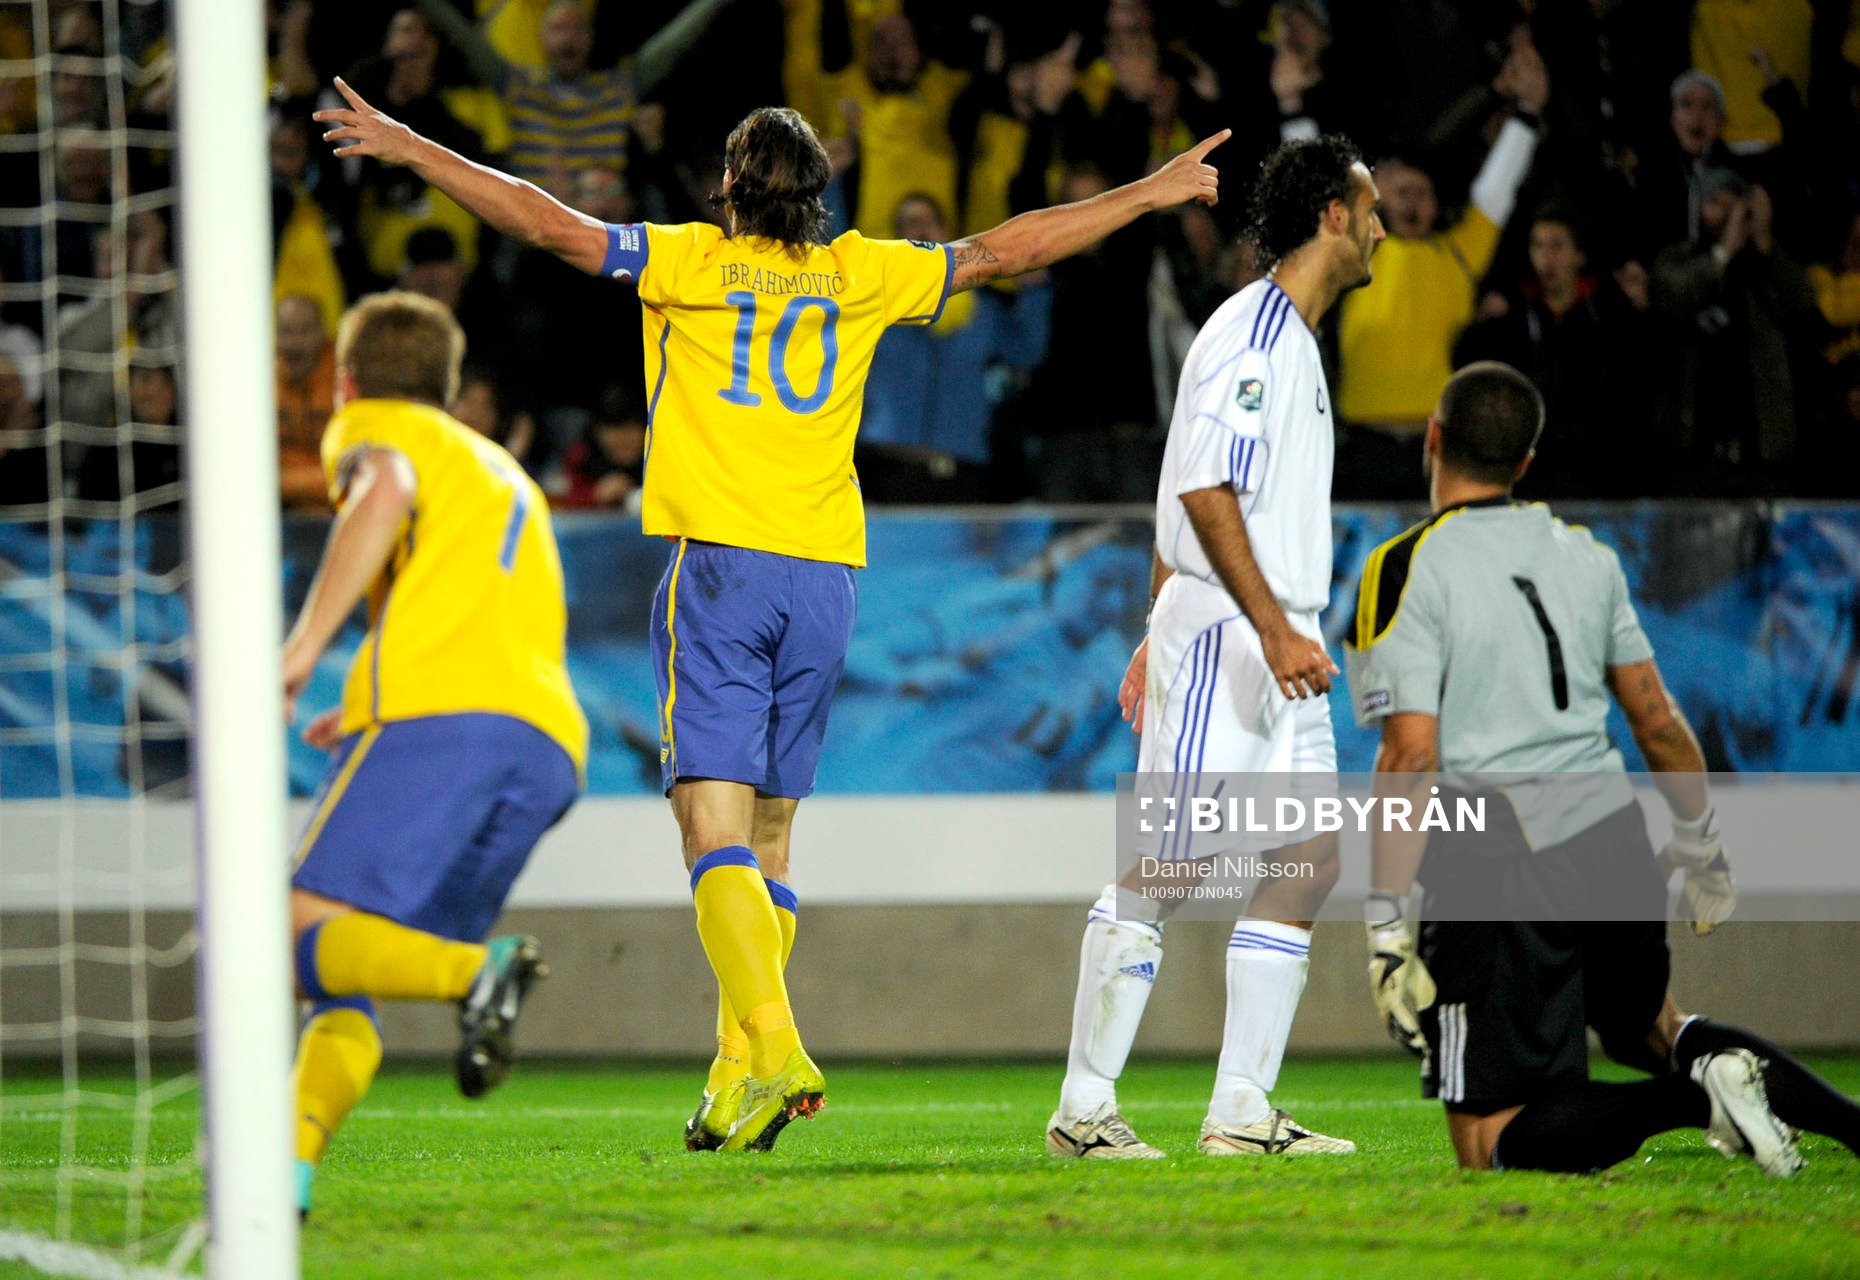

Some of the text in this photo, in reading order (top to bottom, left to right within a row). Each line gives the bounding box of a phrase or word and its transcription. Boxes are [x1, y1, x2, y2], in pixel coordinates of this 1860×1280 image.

[720, 263, 845, 297] IBRAHIMOVIĆ
[717, 290, 840, 414] 10
[1511, 575, 1568, 710] 1
